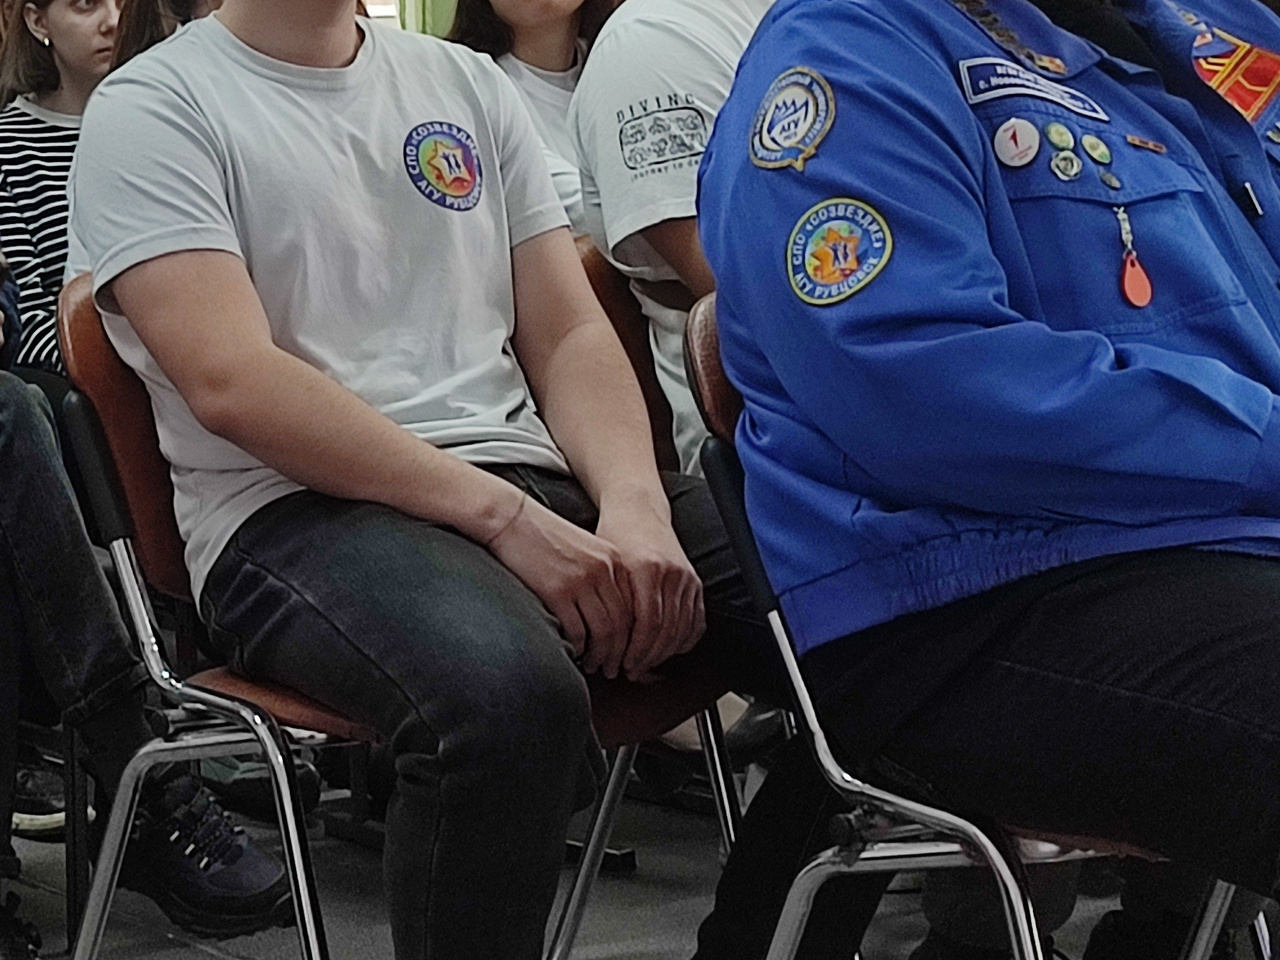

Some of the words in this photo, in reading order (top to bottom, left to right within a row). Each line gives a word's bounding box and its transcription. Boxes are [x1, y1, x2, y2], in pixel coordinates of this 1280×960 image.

[405, 145, 420, 175] СПО
[416, 179, 442, 200] АГУ
[793, 233, 806, 266] СПО
[794, 272, 814, 294] АГУ
[813, 256, 880, 299] РУБЦОВСК
